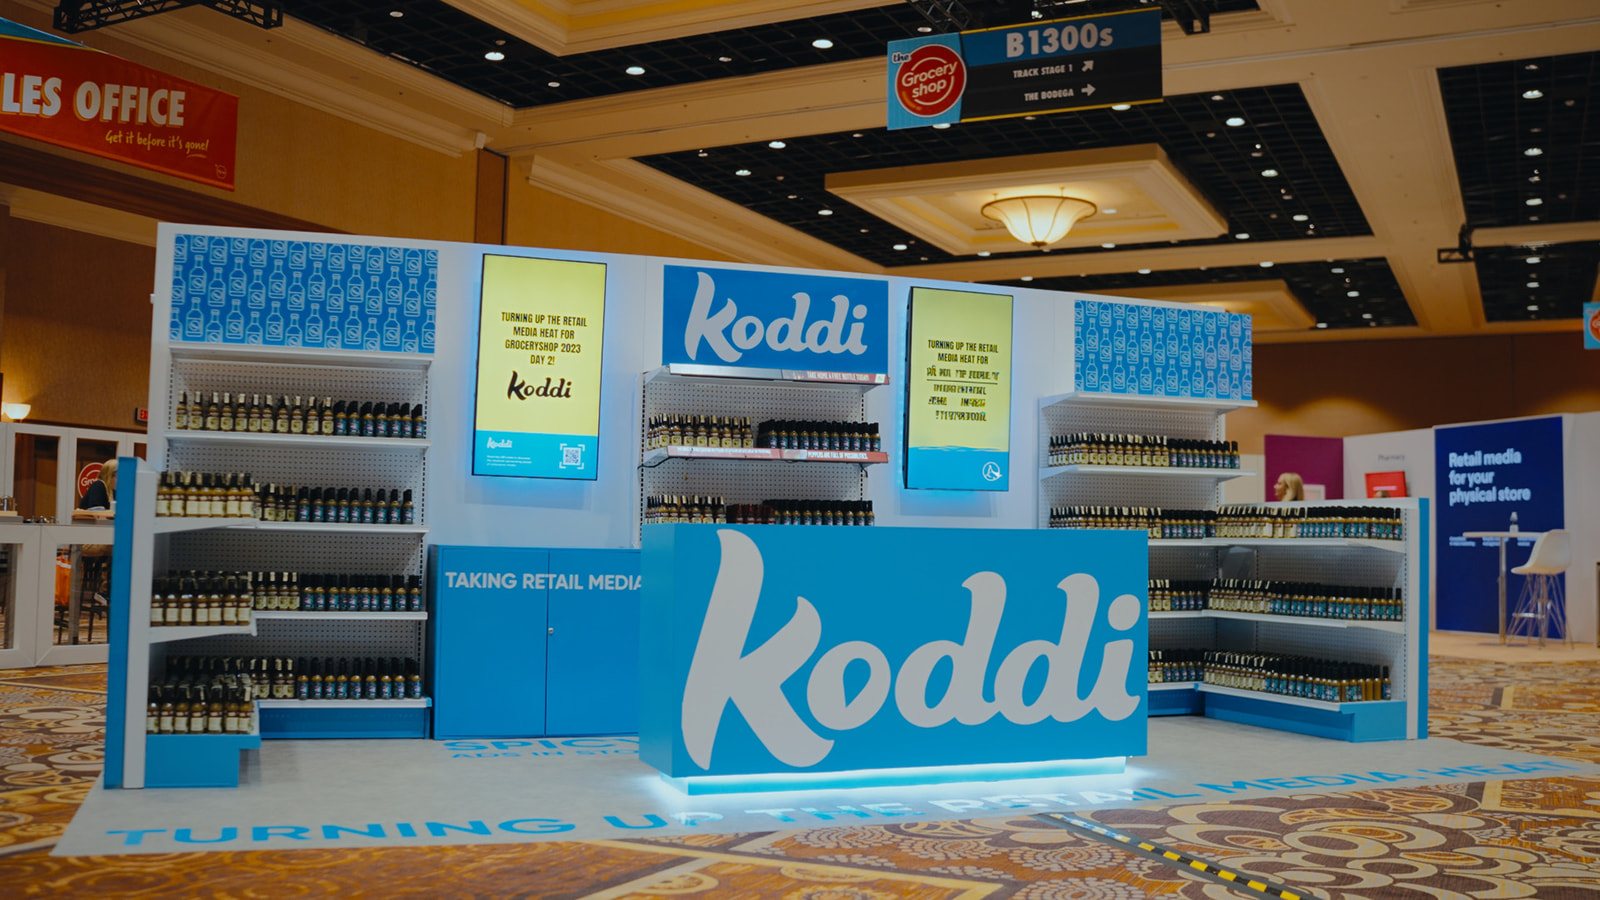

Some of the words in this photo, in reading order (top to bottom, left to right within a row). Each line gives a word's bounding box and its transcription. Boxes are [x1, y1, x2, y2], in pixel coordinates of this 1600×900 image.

[1006, 23, 1114, 58] B1300s
[892, 52, 911, 62] the
[902, 61, 958, 87] Grocery
[1013, 68, 1039, 78] TRACK
[1041, 64, 1065, 75] STAGE
[1068, 64, 1073, 72] 1
[912, 79, 947, 98] shop
[1024, 92, 1039, 102] THE
[1041, 88, 1074, 100] BODEGA
[76, 80, 186, 127] OFFICE
[105, 130, 123, 144] Get
[126, 131, 135, 144] it
[137, 132, 167, 151] before
[168, 136, 182, 149] it's
[185, 139, 209, 154] gone!
[501, 312, 533, 323] TURNING
[535, 314, 546, 324] UP
[547, 315, 561, 325] THE
[563, 316, 588, 327] RETAIL
[513, 326, 538, 337] MEDIA
[540, 328, 559, 339] HEAT
[560, 329, 575, 340] FOR
[505, 339, 559, 352] GROCERYSHOP
[561, 343, 582, 354] 2023
[928, 339, 955, 350] TURNING
[955, 341, 964, 351] UP
[966, 342, 977, 352] THE
[978, 343, 999, 353] RETAIL
[530, 354, 545, 365] DAY
[547, 355, 556, 366] 2!
[938, 353, 958, 362] MEDIA
[960, 354, 975, 364] HEAT
[976, 355, 989, 365] FOR
[1449, 450, 1482, 468] Retail
[1483, 448, 1522, 466] media
[1449, 470, 1466, 485] for
[1467, 471, 1495, 488] your
[1449, 486, 1497, 506] physical
[1498, 486, 1531, 501] store
[445, 572, 517, 589] TAKING
[522, 573, 584, 590] RETAIL
[588, 574, 641, 591] MEDIA
[106, 818, 576, 846] TURNING
[603, 811, 724, 829] UP
[744, 802, 927, 822] THE
[927, 787, 1202, 813] RETAIL
[1195, 769, 1427, 794] MEDIA
[1417, 760, 1581, 779] HEAT
